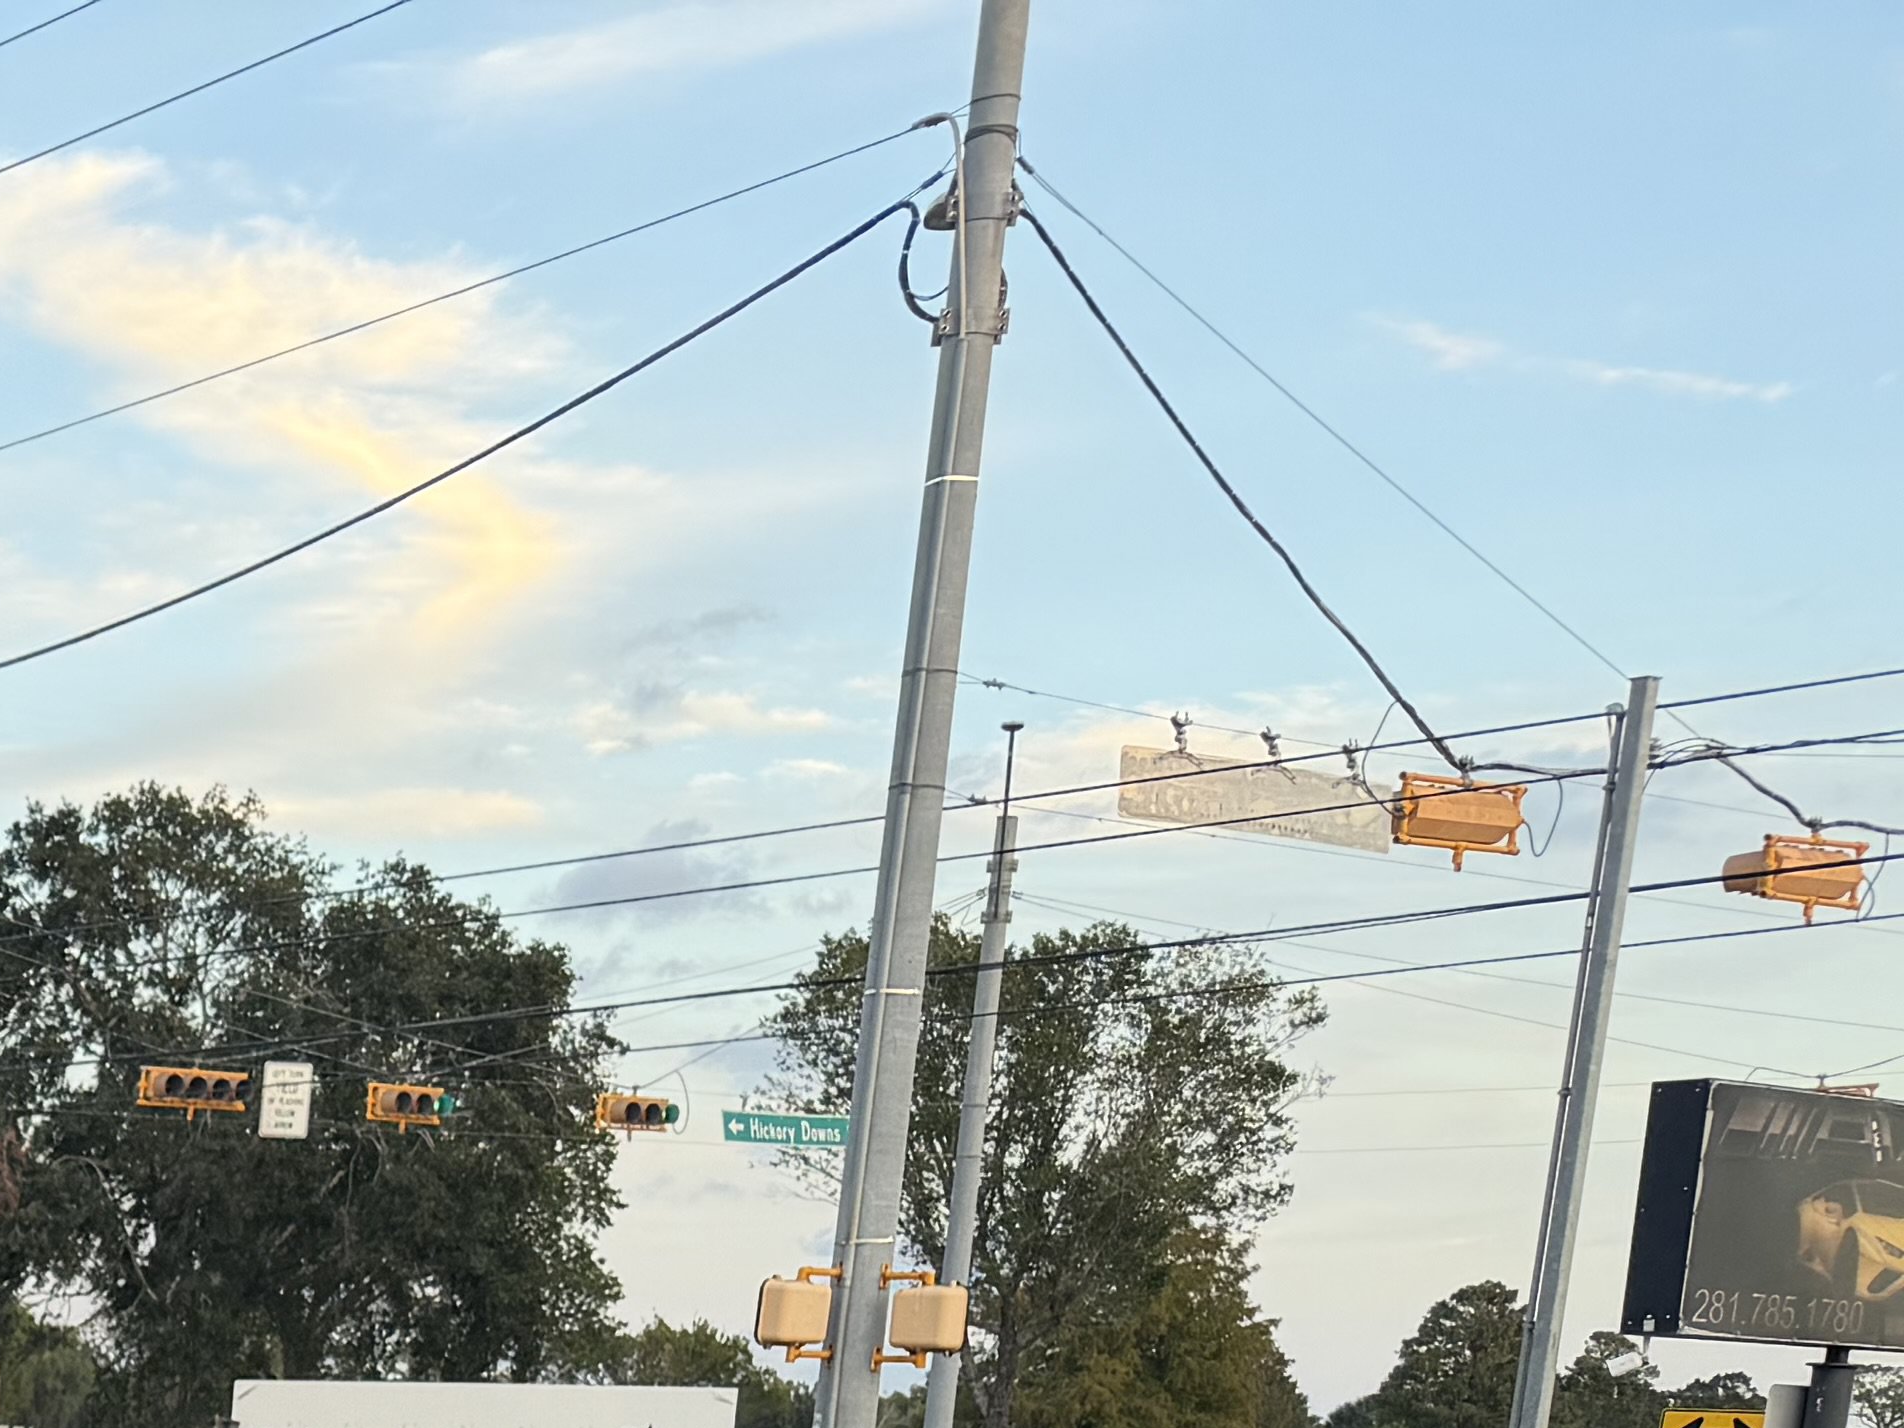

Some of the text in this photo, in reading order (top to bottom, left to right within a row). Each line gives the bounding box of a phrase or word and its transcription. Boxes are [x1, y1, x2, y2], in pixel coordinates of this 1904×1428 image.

[750, 1118, 840, 1144] Hickory Downs
[1692, 1288, 1863, 1334] 281.785.1780
